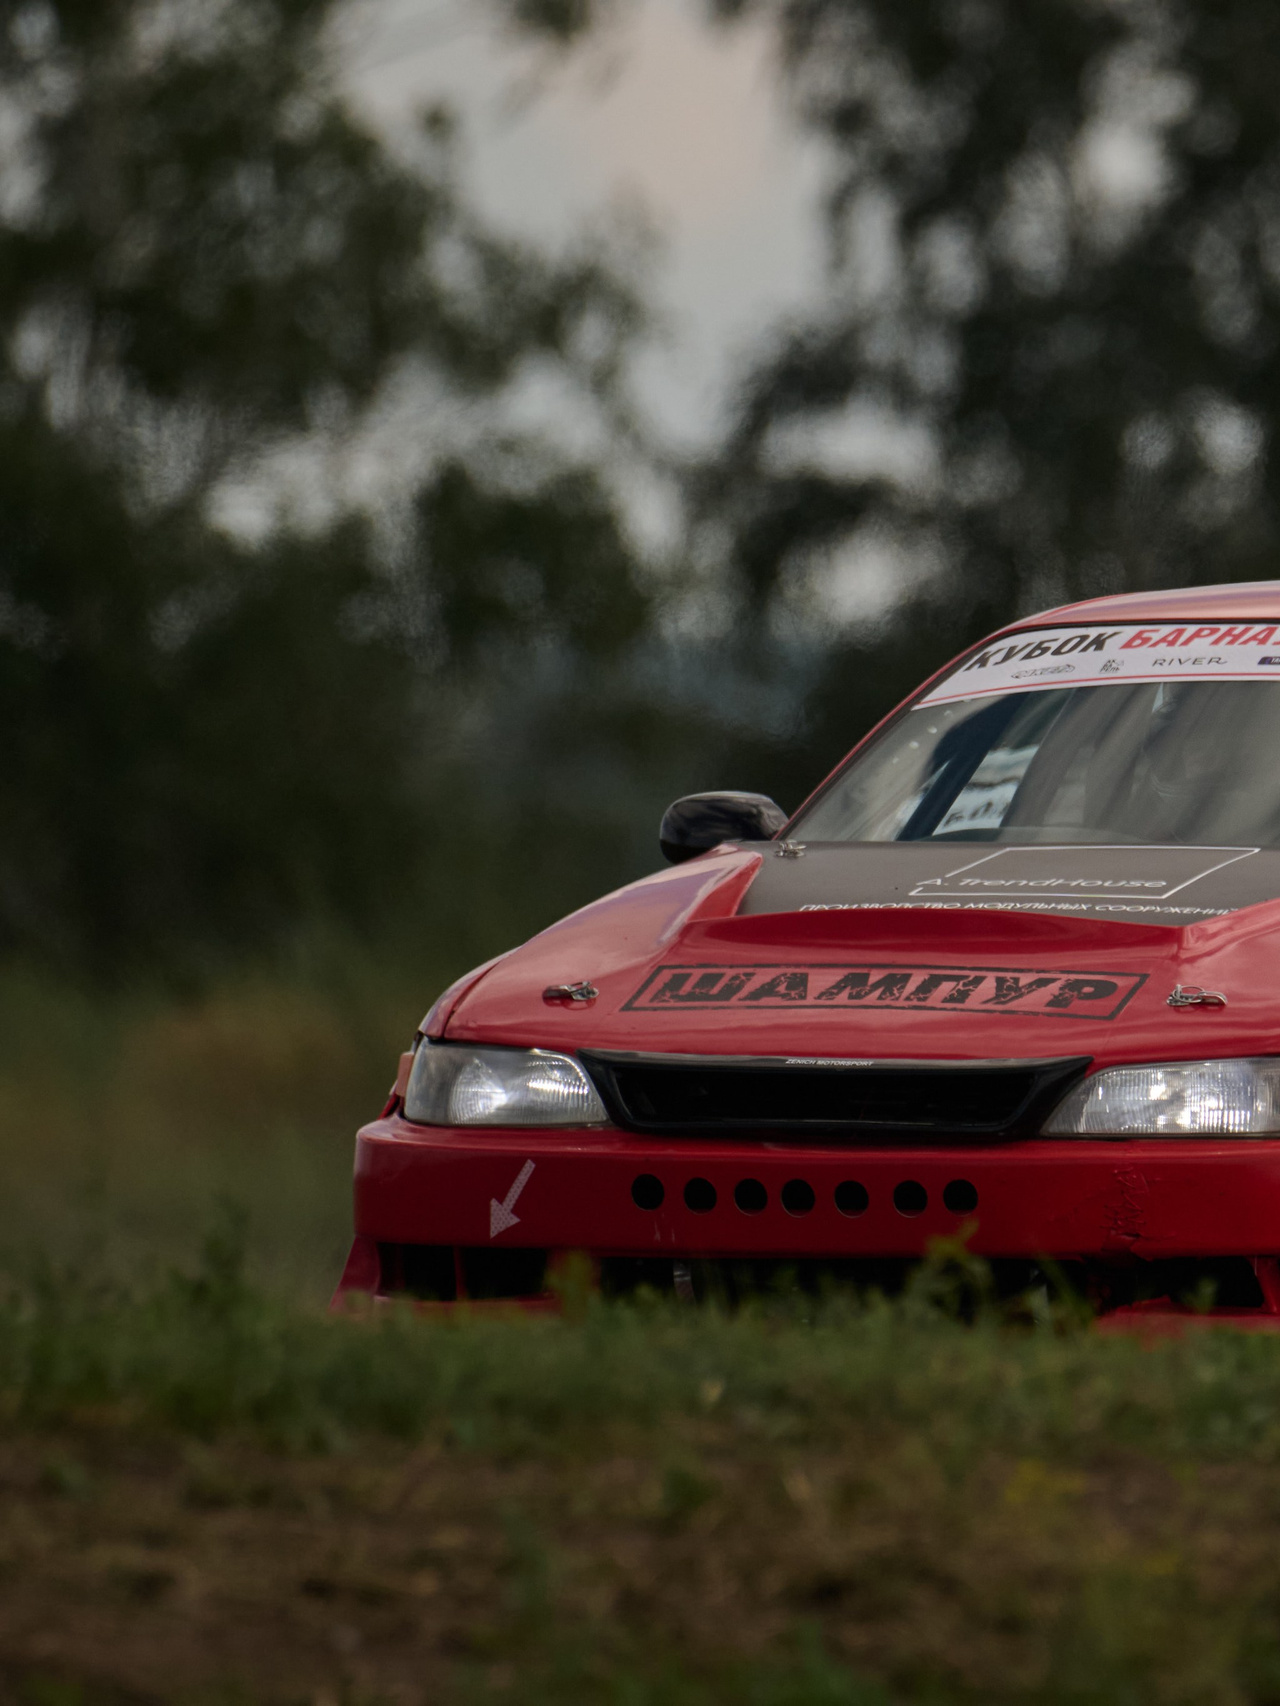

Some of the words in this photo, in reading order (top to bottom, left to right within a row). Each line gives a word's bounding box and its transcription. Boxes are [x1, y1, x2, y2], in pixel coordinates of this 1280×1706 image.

[962, 631, 1125, 672] КУБОК
[1152, 657, 1228, 667] RIVER
[958, 878, 1167, 889] TrendHouse
[654, 972, 1119, 1009] ШАМПУР
